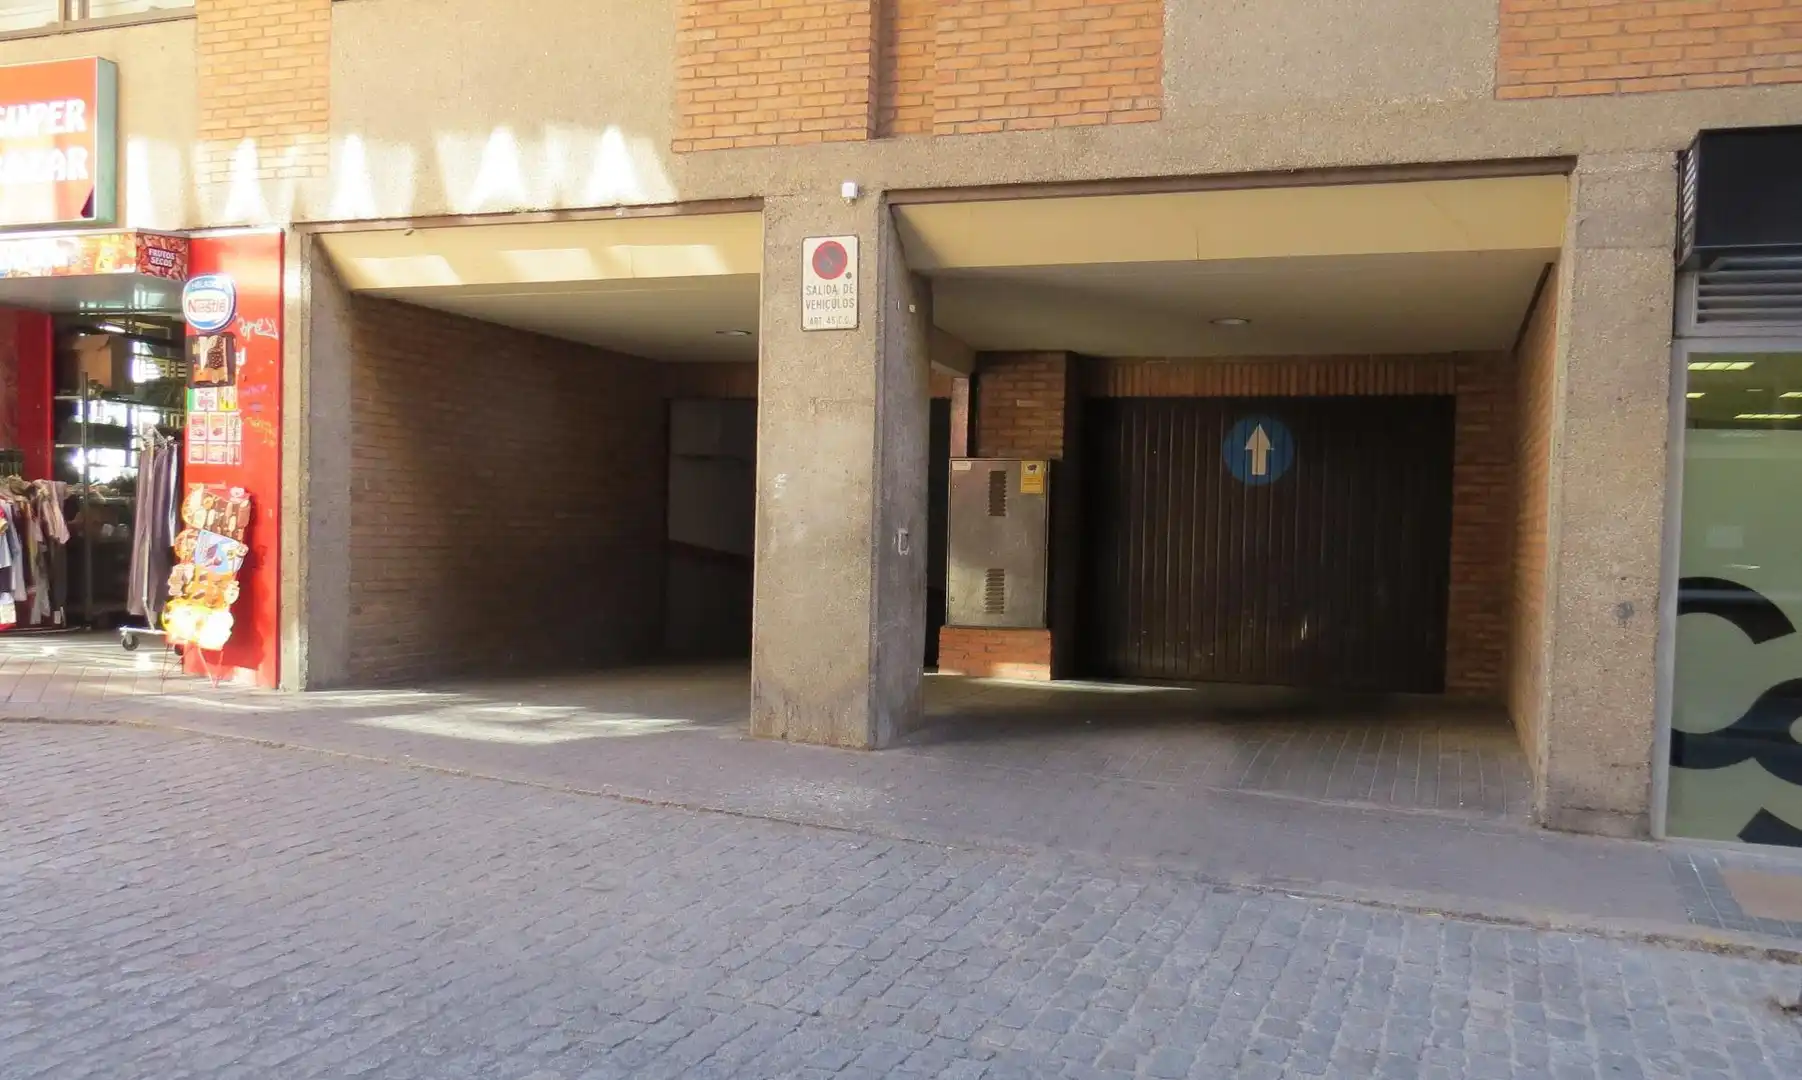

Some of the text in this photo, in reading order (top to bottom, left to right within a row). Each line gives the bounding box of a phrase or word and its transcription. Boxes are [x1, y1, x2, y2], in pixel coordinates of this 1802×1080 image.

[148, 248, 176, 260] FRUTOS
[150, 256, 173, 268] SECOS
[806, 283, 854, 296] SALIDA DE
[805, 297, 855, 310] VEHICULOS
